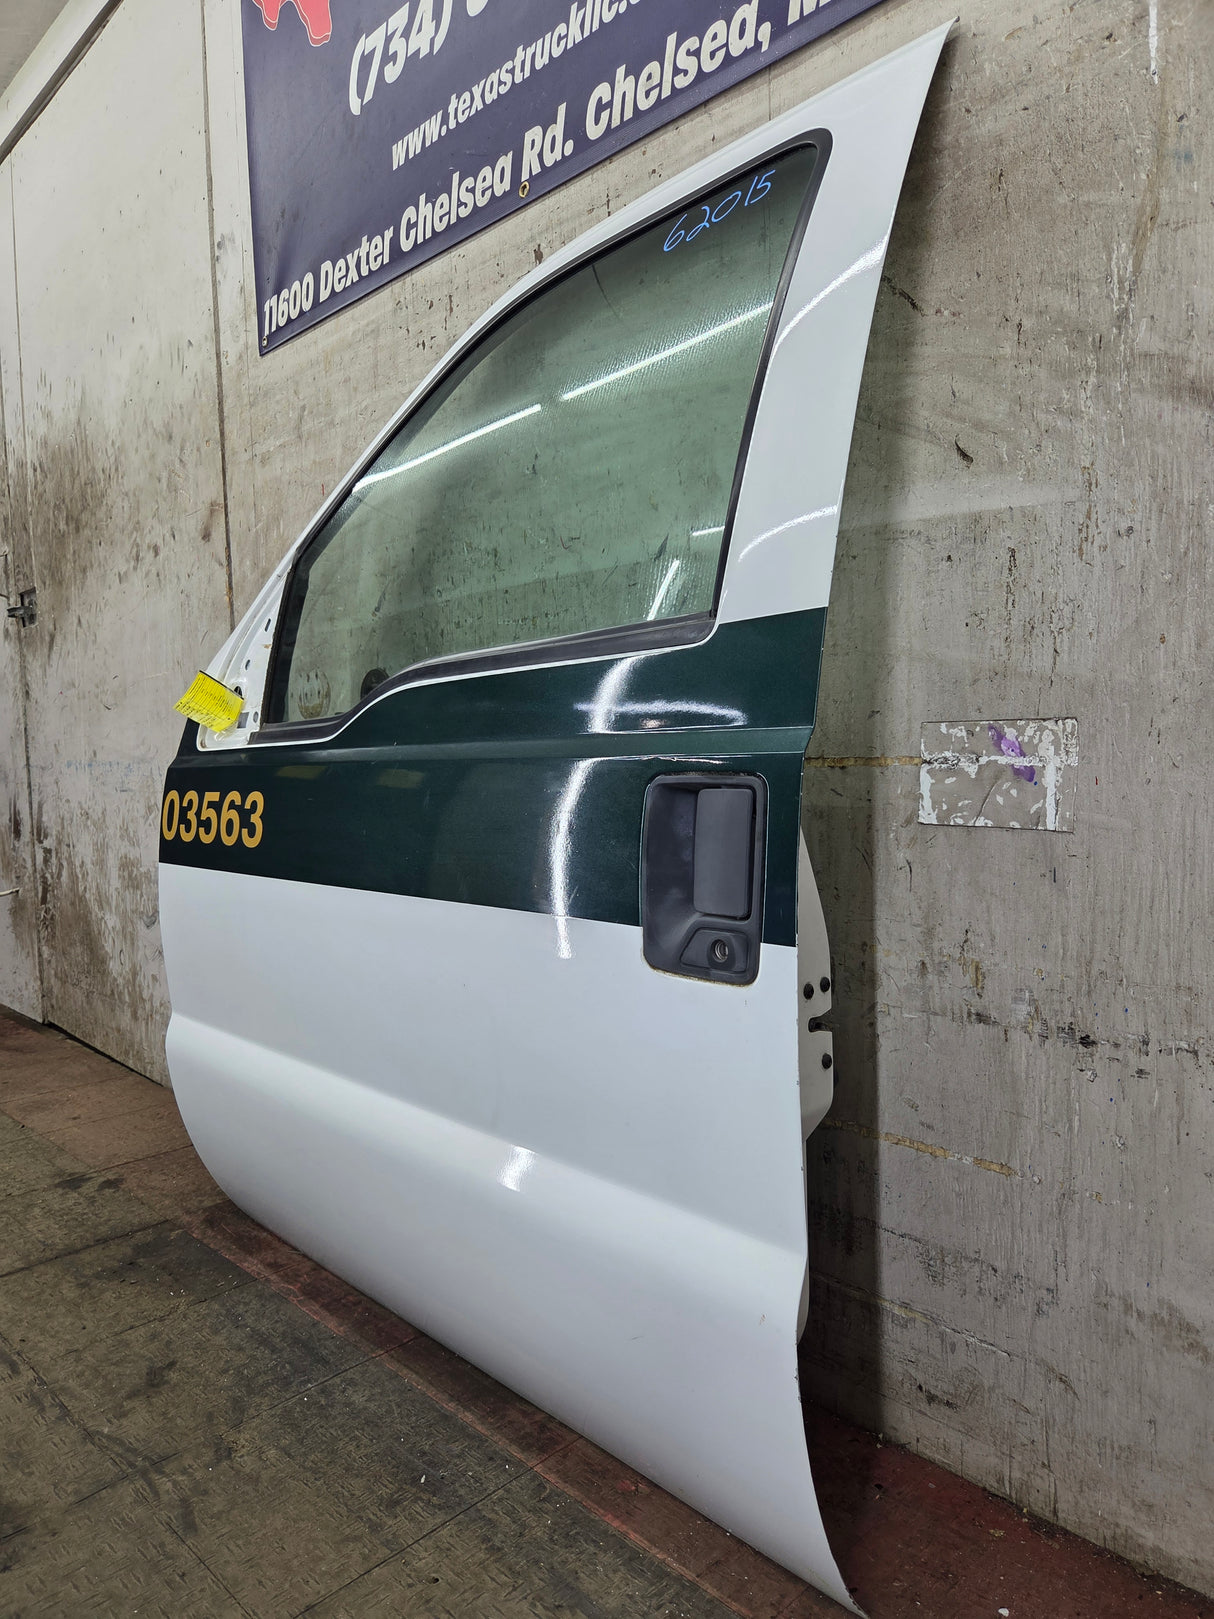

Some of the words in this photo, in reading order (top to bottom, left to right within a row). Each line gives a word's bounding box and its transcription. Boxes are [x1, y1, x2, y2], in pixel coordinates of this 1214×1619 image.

[392, 0, 641, 171] www.texastruckllc.
[264, 271, 315, 337] 11600
[319, 225, 394, 303] Dexter
[400, 150, 513, 252] Chelsea
[521, 102, 574, 182] Rd.
[585, 0, 772, 141] Chelsea,
[663, 169, 776, 252] 62015
[162, 789, 265, 848] 03563
